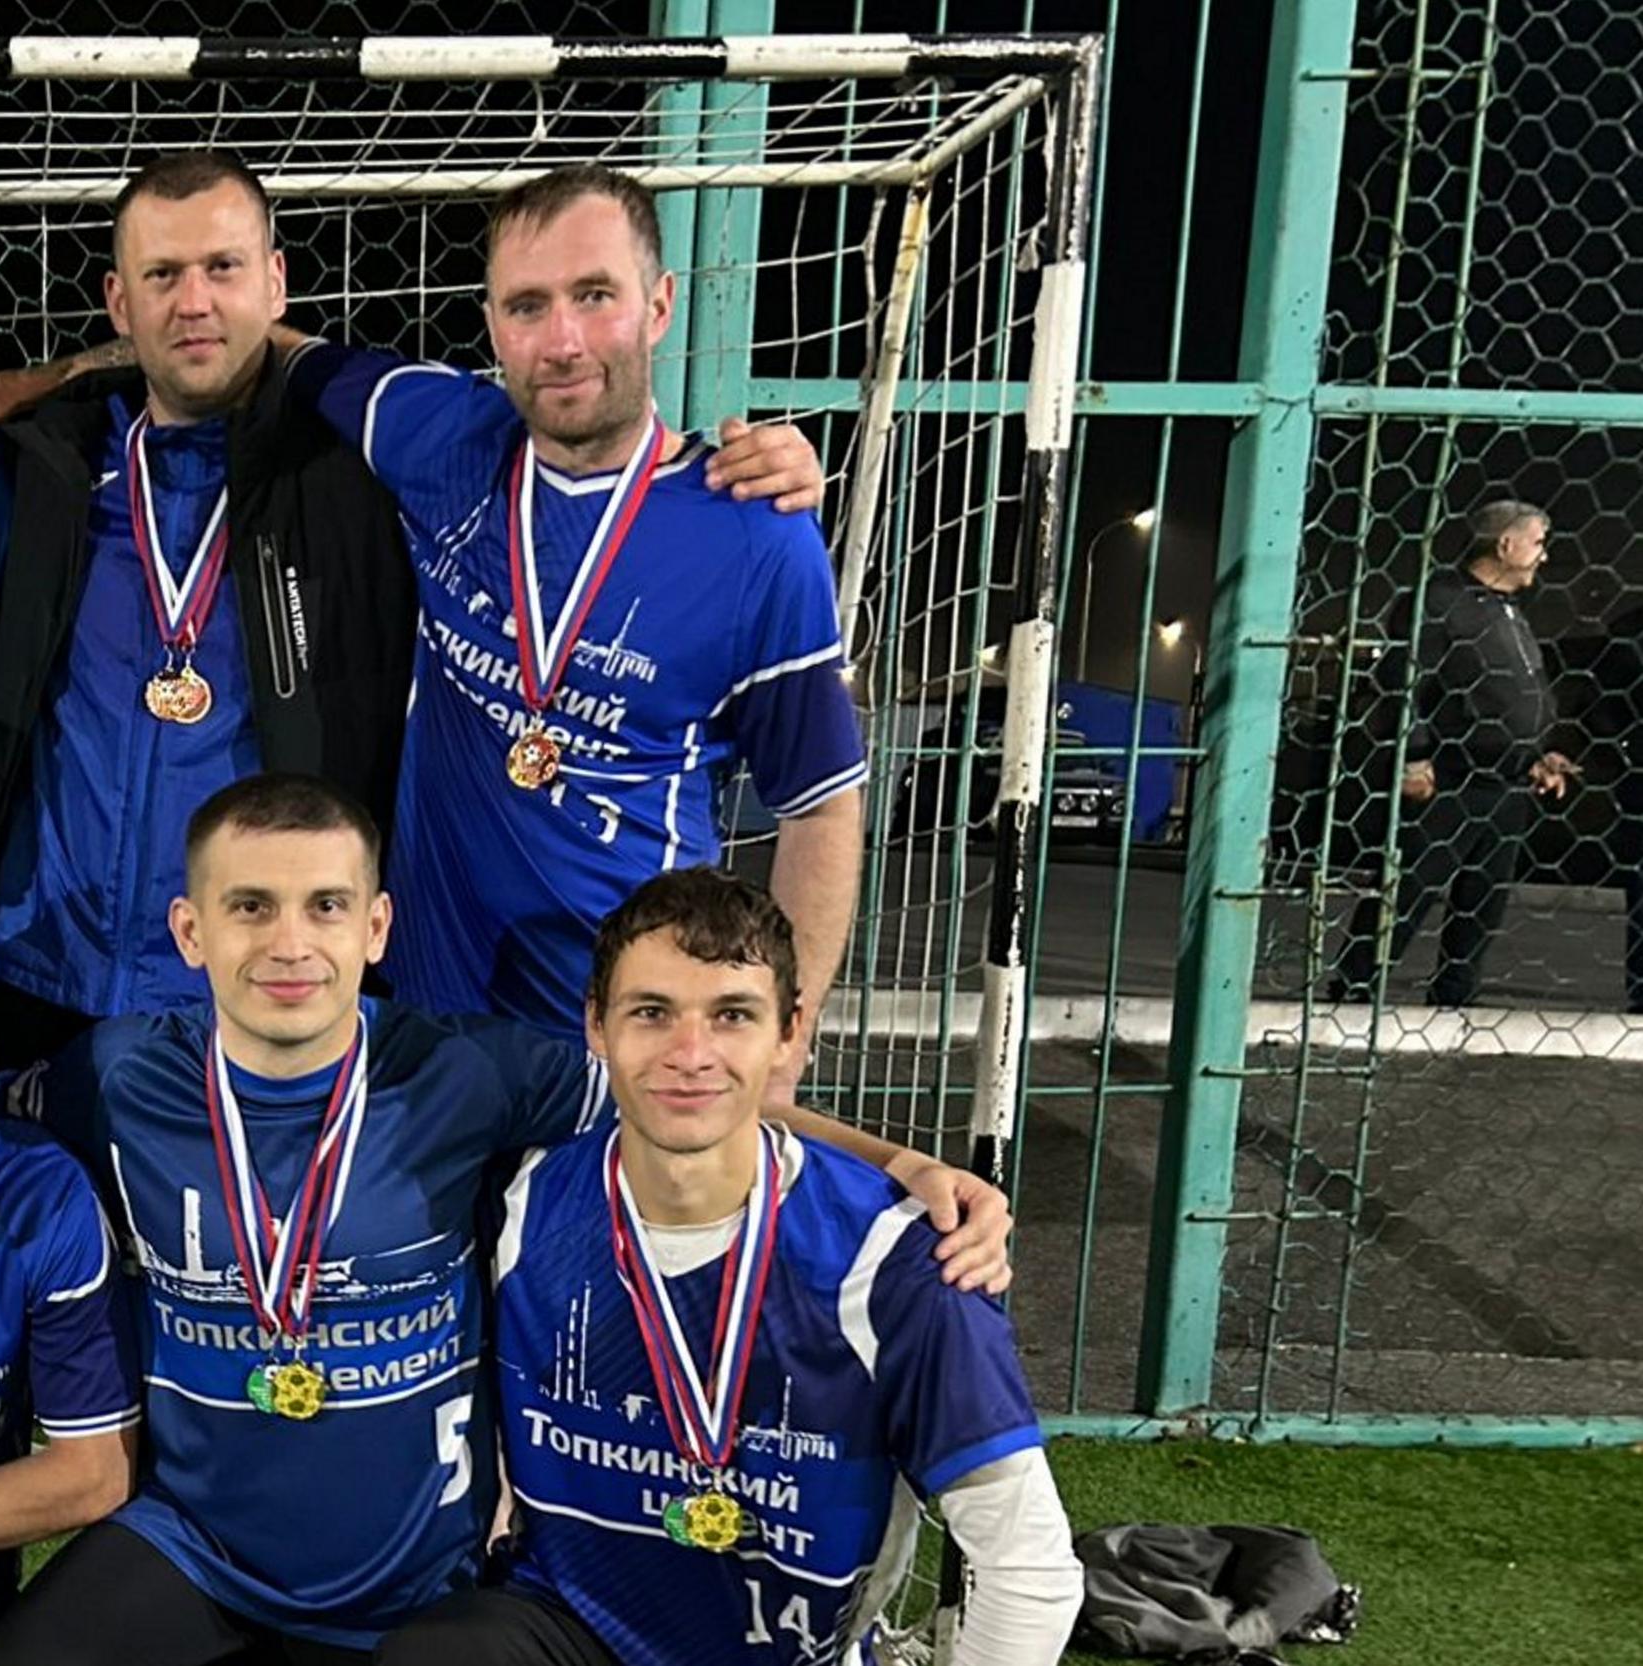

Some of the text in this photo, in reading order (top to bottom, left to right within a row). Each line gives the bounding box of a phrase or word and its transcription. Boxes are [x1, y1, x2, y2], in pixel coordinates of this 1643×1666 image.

[314, 1332, 466, 1392] емент
[435, 1394, 474, 1508] 5
[521, 1408, 800, 1514] Топкинский
[743, 1578, 817, 1660] 14
